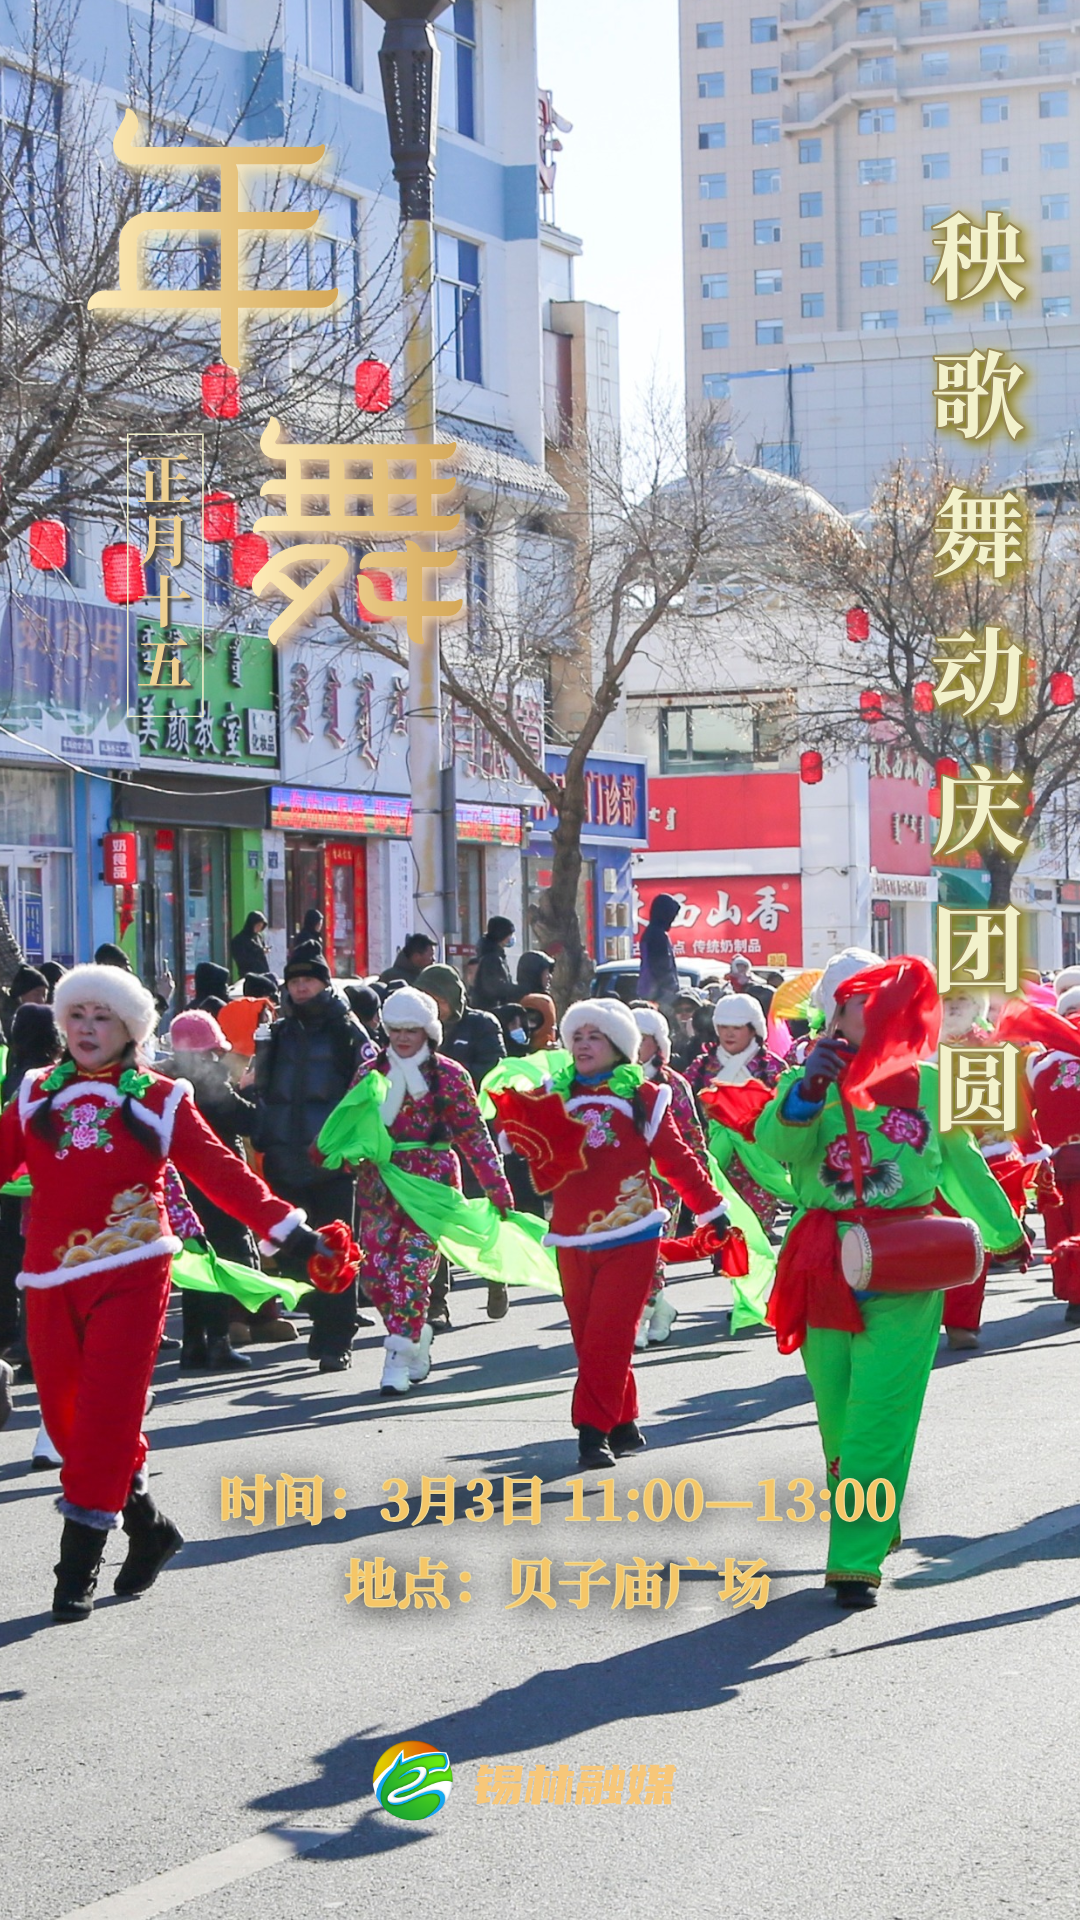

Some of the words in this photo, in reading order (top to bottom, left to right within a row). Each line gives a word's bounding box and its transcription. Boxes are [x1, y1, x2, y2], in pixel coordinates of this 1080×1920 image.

[138, 695, 243, 757] 美颜教室
[251, 733, 276, 753] 化妆品
[112, 838, 129, 881] 奶食品
[693, 939, 762, 955] 传统奶制品
